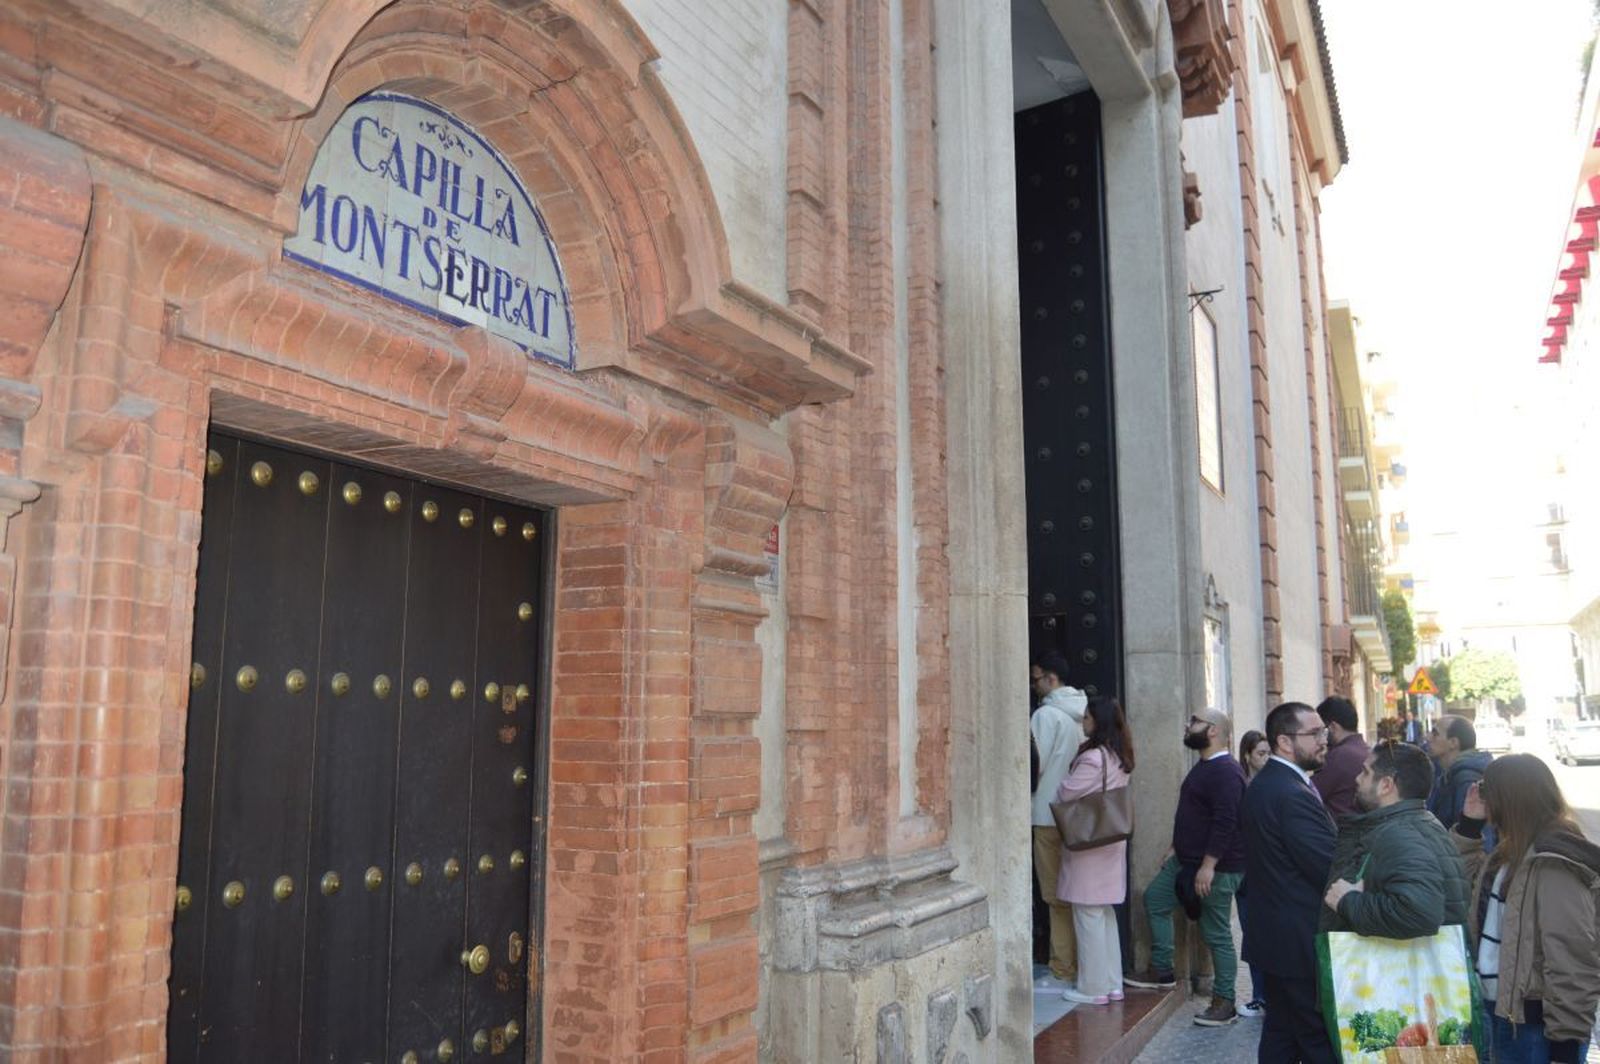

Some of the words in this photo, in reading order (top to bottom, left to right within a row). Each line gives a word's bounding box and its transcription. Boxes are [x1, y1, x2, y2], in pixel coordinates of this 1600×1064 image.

[352, 116, 519, 246] CAPILLA
[422, 207, 461, 242] DE
[301, 184, 556, 338] MONTSERRAT
